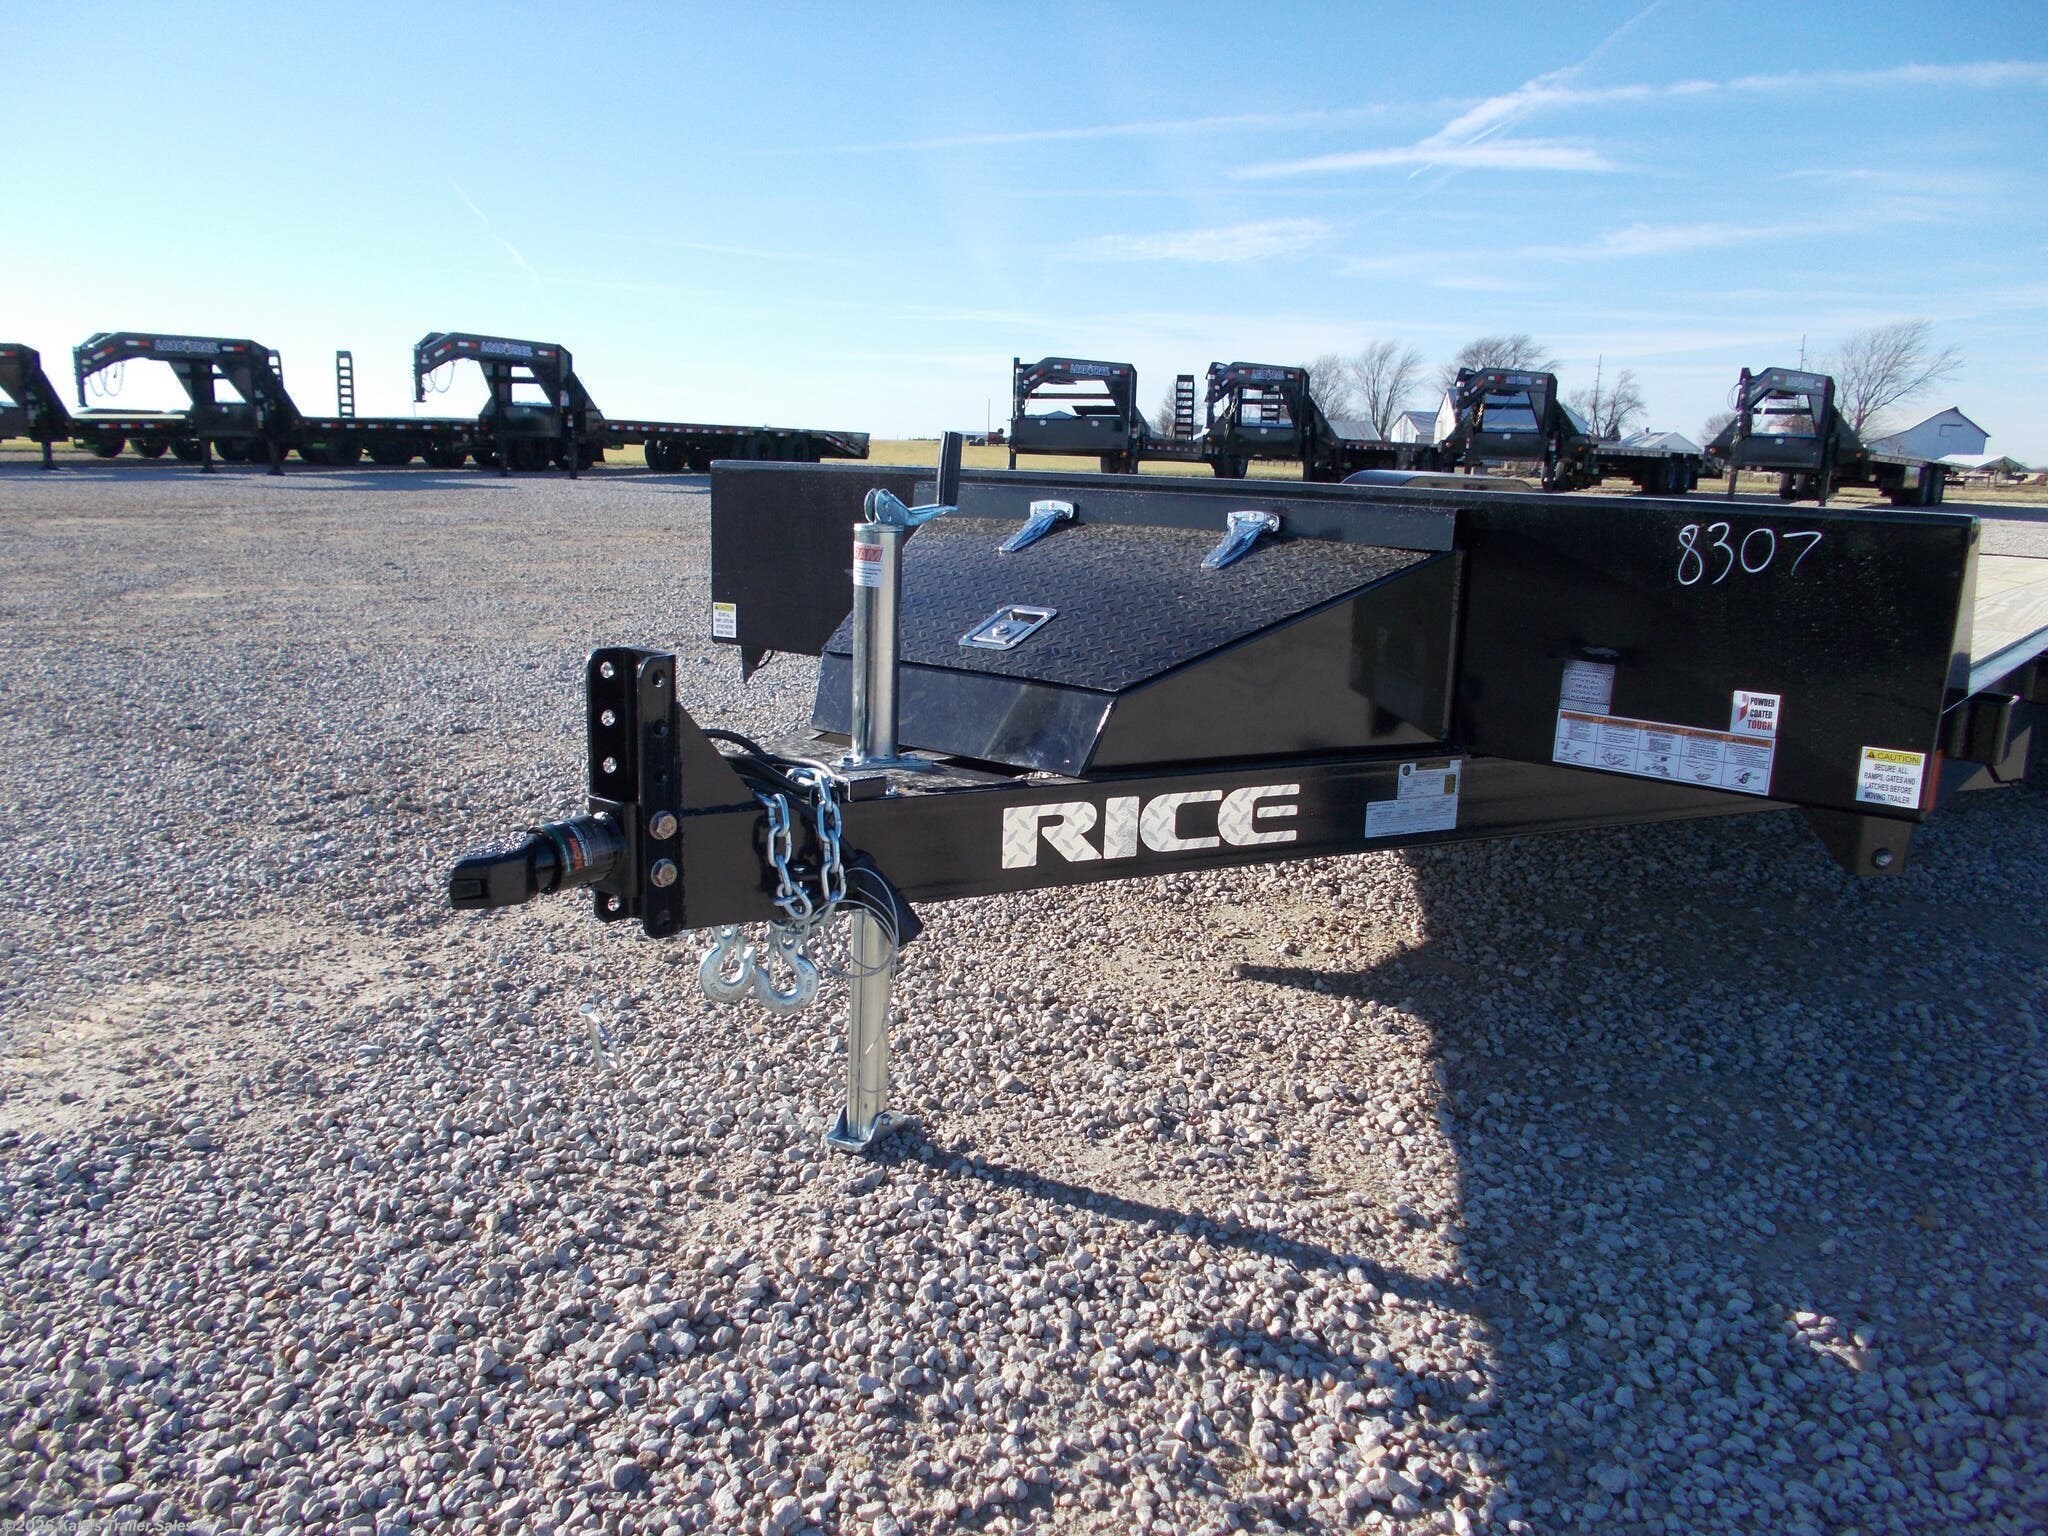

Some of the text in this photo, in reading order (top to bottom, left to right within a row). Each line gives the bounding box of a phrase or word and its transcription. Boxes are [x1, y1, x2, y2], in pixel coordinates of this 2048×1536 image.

[1677, 522, 1823, 585] 8307
[1750, 696, 1775, 707] POWDER
[1750, 709, 1773, 719] COATED
[1747, 719, 1773, 731] TOUGH
[1877, 752, 1919, 764] CAUTION
[1874, 763, 1908, 775] SECURE ALL
[1885, 775, 1903, 784] GATES
[1864, 782, 1912, 795] LATCHES BEFORE
[1864, 791, 1910, 804] MOVING TRAILER
[1002, 784, 1300, 869] RICE
